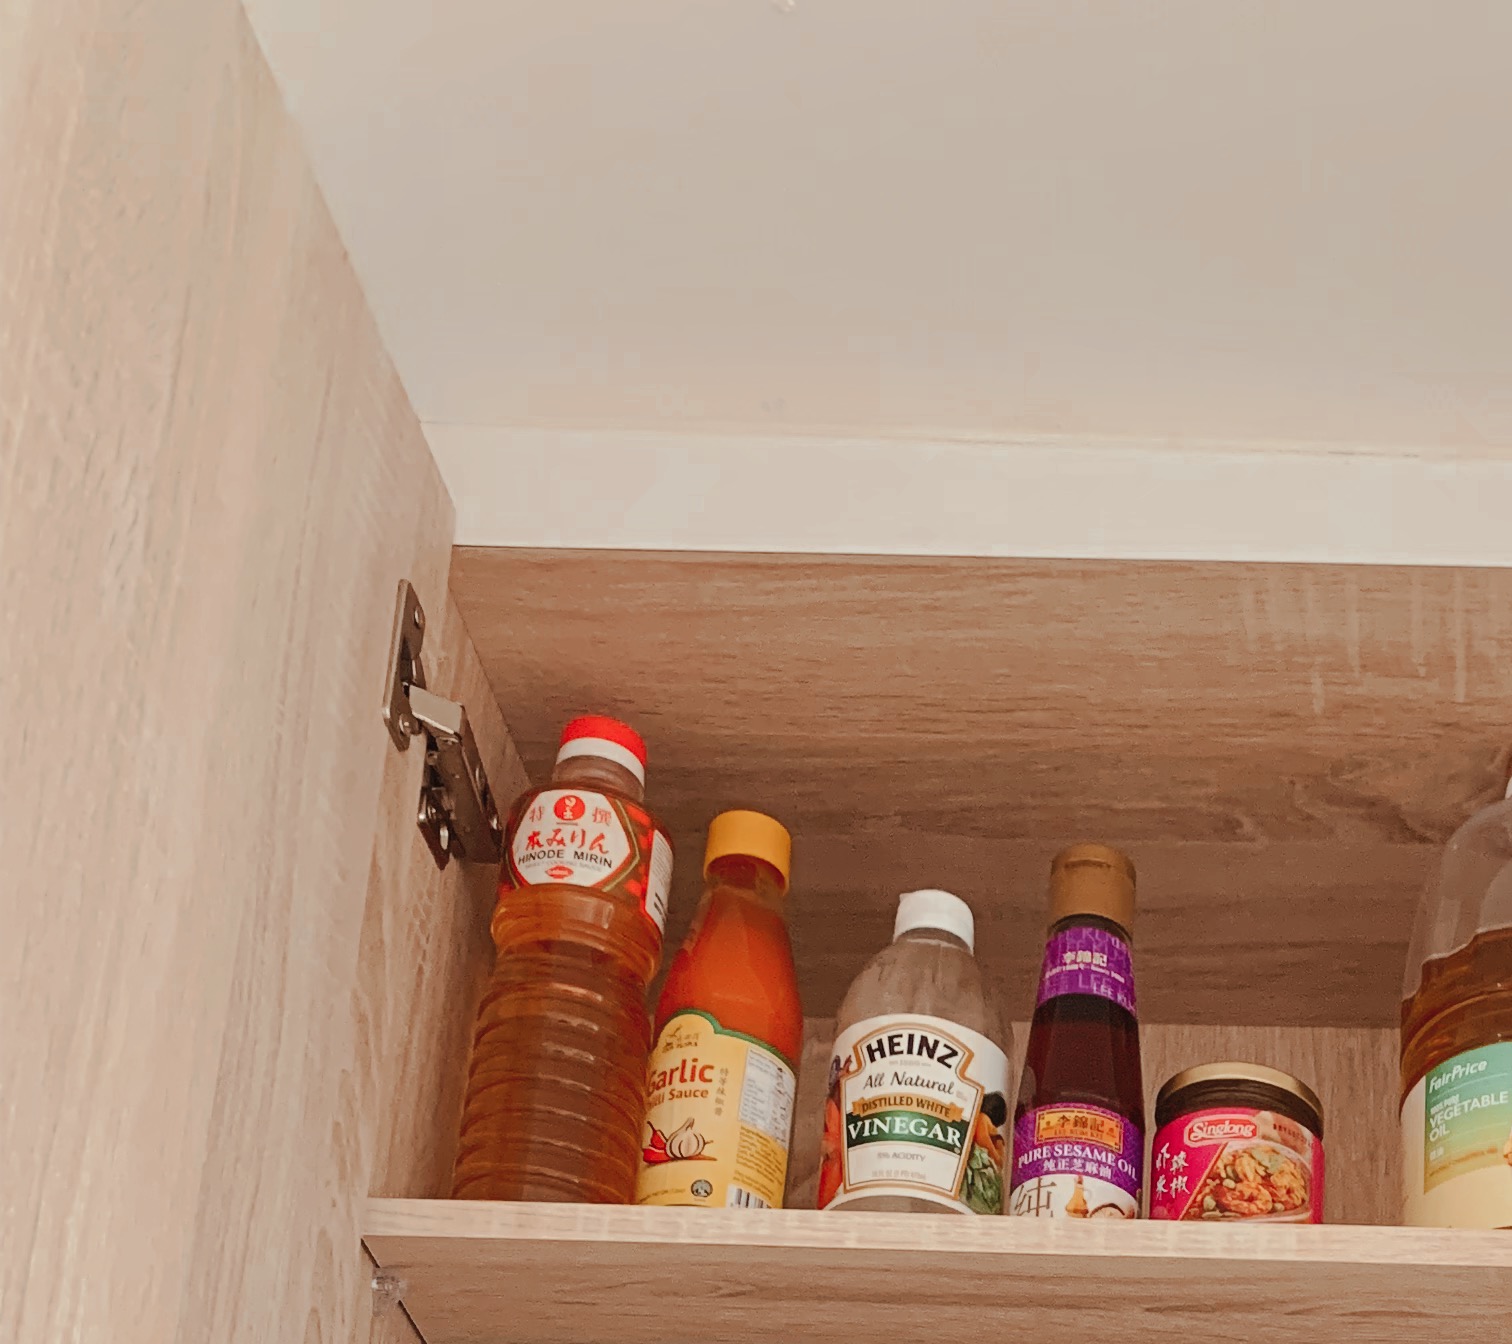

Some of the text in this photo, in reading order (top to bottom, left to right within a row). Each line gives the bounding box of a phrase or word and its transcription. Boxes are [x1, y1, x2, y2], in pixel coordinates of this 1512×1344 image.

[517, 849, 613, 869] HINODE MIRIN
[866, 1033, 959, 1069] HEINZ
[863, 1073, 885, 1090] All
[890, 1071, 955, 1095] Natural
[1429, 1060, 1488, 1094] FairPrice
[668, 1089, 709, 1100] Sauce
[862, 1096, 951, 1118] DISTILLED WHITE
[1429, 1091, 1509, 1128] VEGETABLE
[848, 1117, 962, 1148] VINEGAR
[1189, 1120, 1256, 1141] Singlong
[1429, 1124, 1450, 1142] OIL
[892, 1152, 926, 1162] ACIDITY
[1018, 1145, 1052, 1168] PURE
[1053, 1143, 1117, 1167] SESAME
